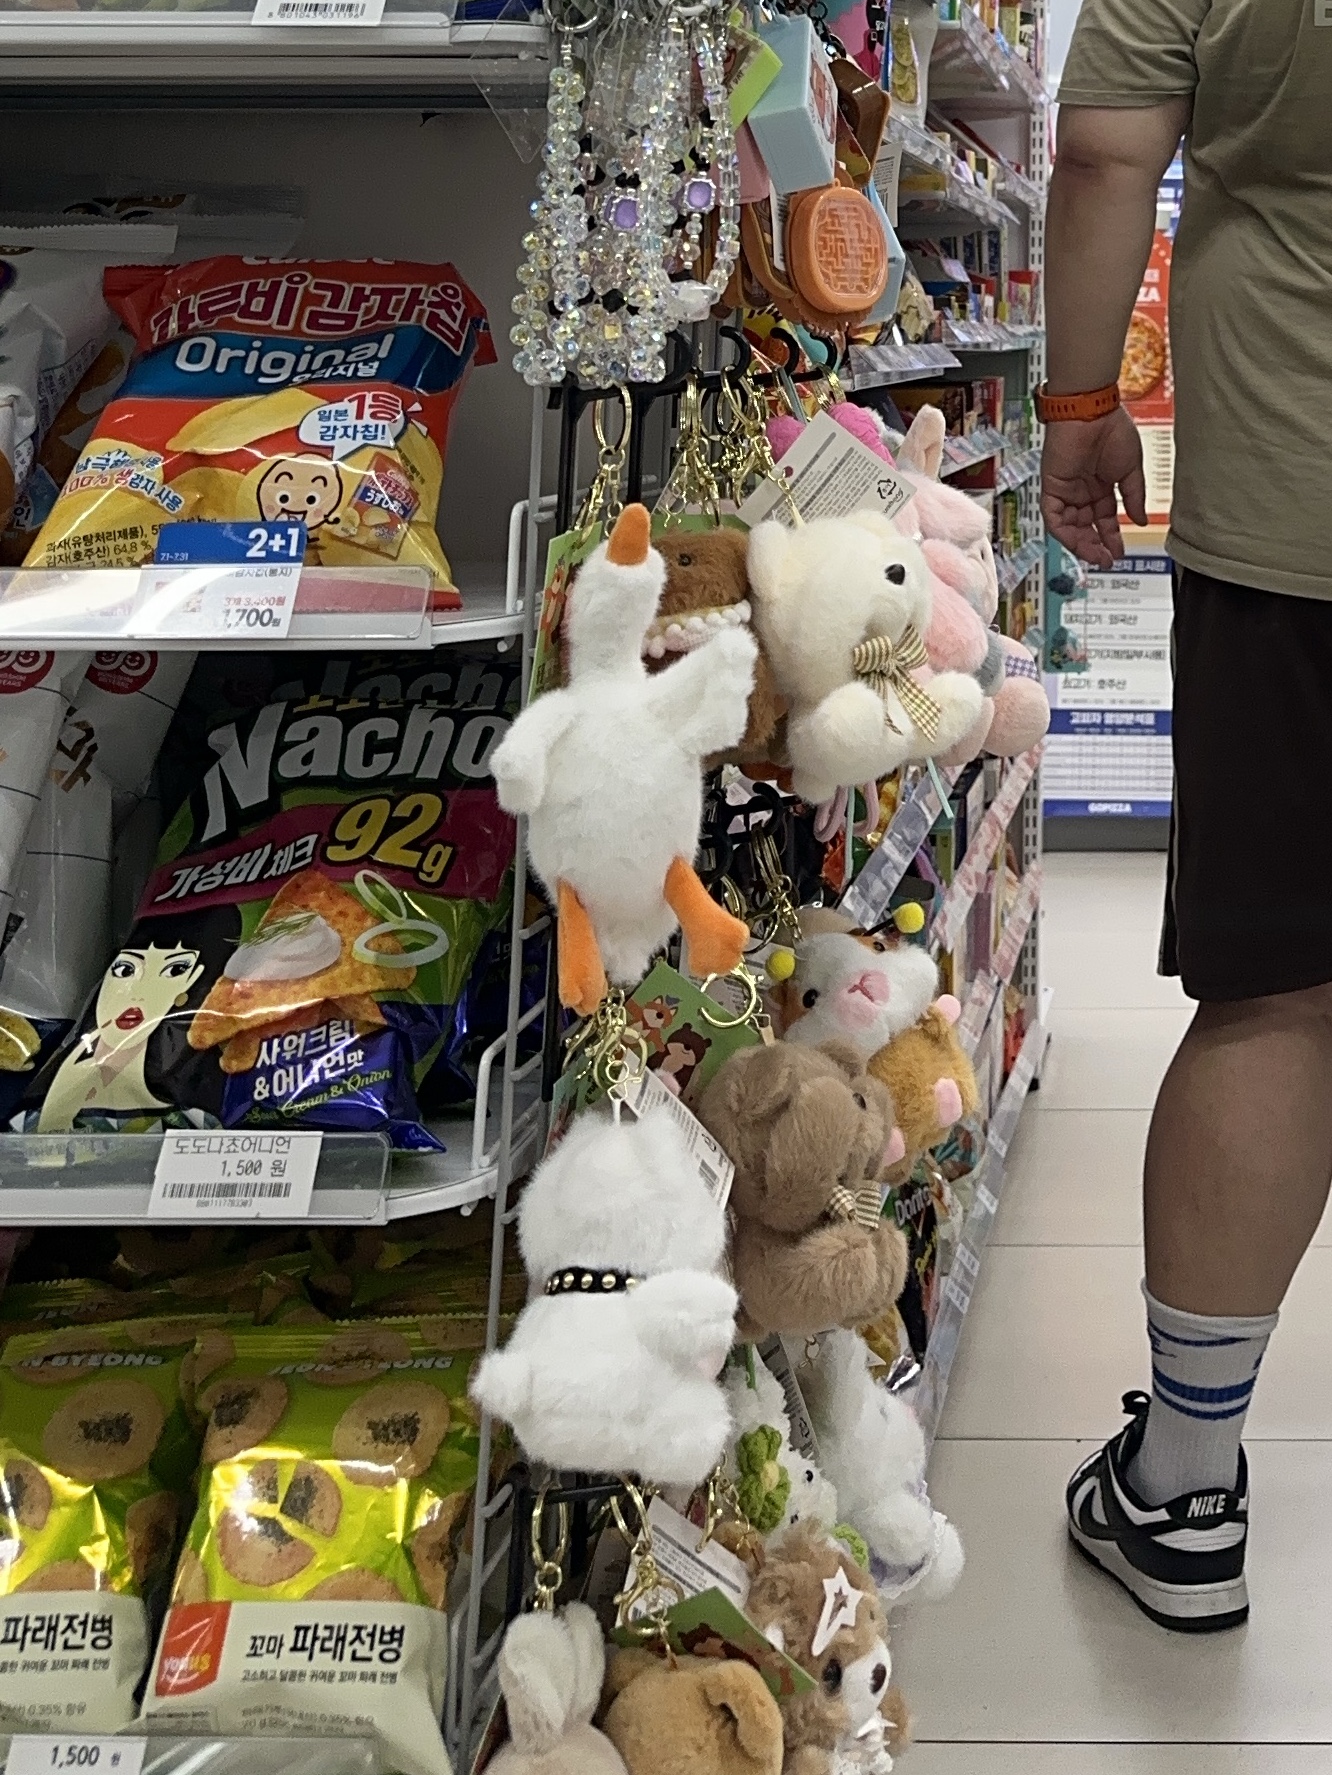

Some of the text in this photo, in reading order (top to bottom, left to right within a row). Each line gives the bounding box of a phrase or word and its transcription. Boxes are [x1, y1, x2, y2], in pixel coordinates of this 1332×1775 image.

[175, 332, 396, 384] Original
[318, 423, 387, 441] 감자칩!
[154, 484, 186, 513] 사용
[245, 527, 301, 559] 2+1
[201, 700, 513, 842] Nacho
[326, 792, 454, 884] 92g
[154, 832, 320, 904] 가성비 체크
[255, 1018, 352, 1070] 사워크림
[172, 1136, 293, 1155] 도도나쵸어니언
[220, 1158, 288, 1178] 1,500 원
[1185, 1493, 1227, 1519] NIKE
[1, 1611, 115, 1655] 파래전병
[245, 1623, 406, 1666] 꼬마 파래전병
[49, 1744, 101, 1768] 1,500
